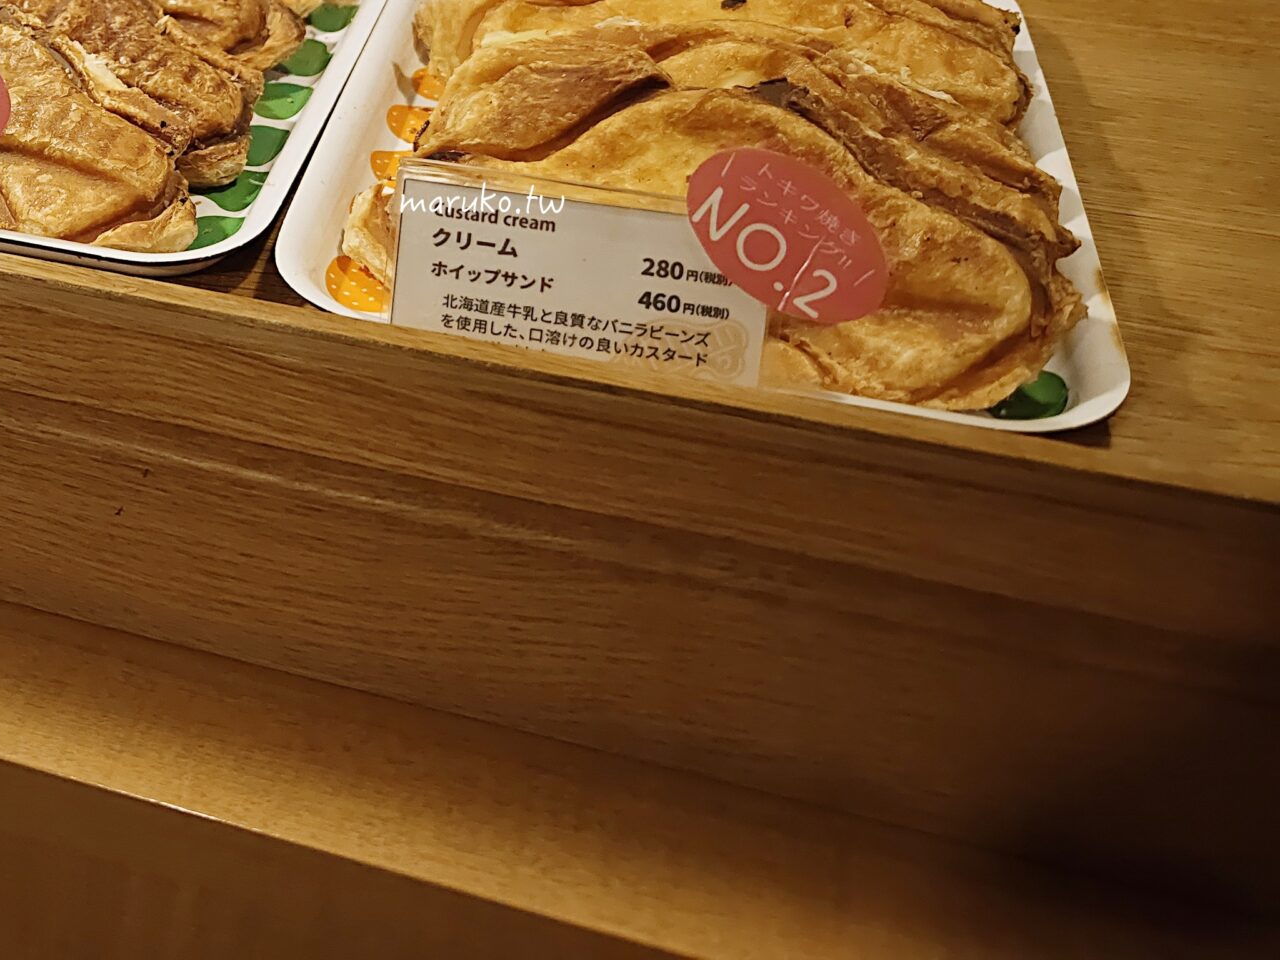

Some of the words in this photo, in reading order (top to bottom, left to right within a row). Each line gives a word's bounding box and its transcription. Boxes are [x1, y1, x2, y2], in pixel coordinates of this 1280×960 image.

[503, 214, 556, 232] cream
[758, 163, 862, 247] トキワ焼き
[432, 228, 518, 258] クリーム
[691, 186, 838, 319] NO.2
[431, 261, 554, 293] ホイップサンド
[442, 294, 711, 347] 北海道産牛乳と良質なバニラビーンズ
